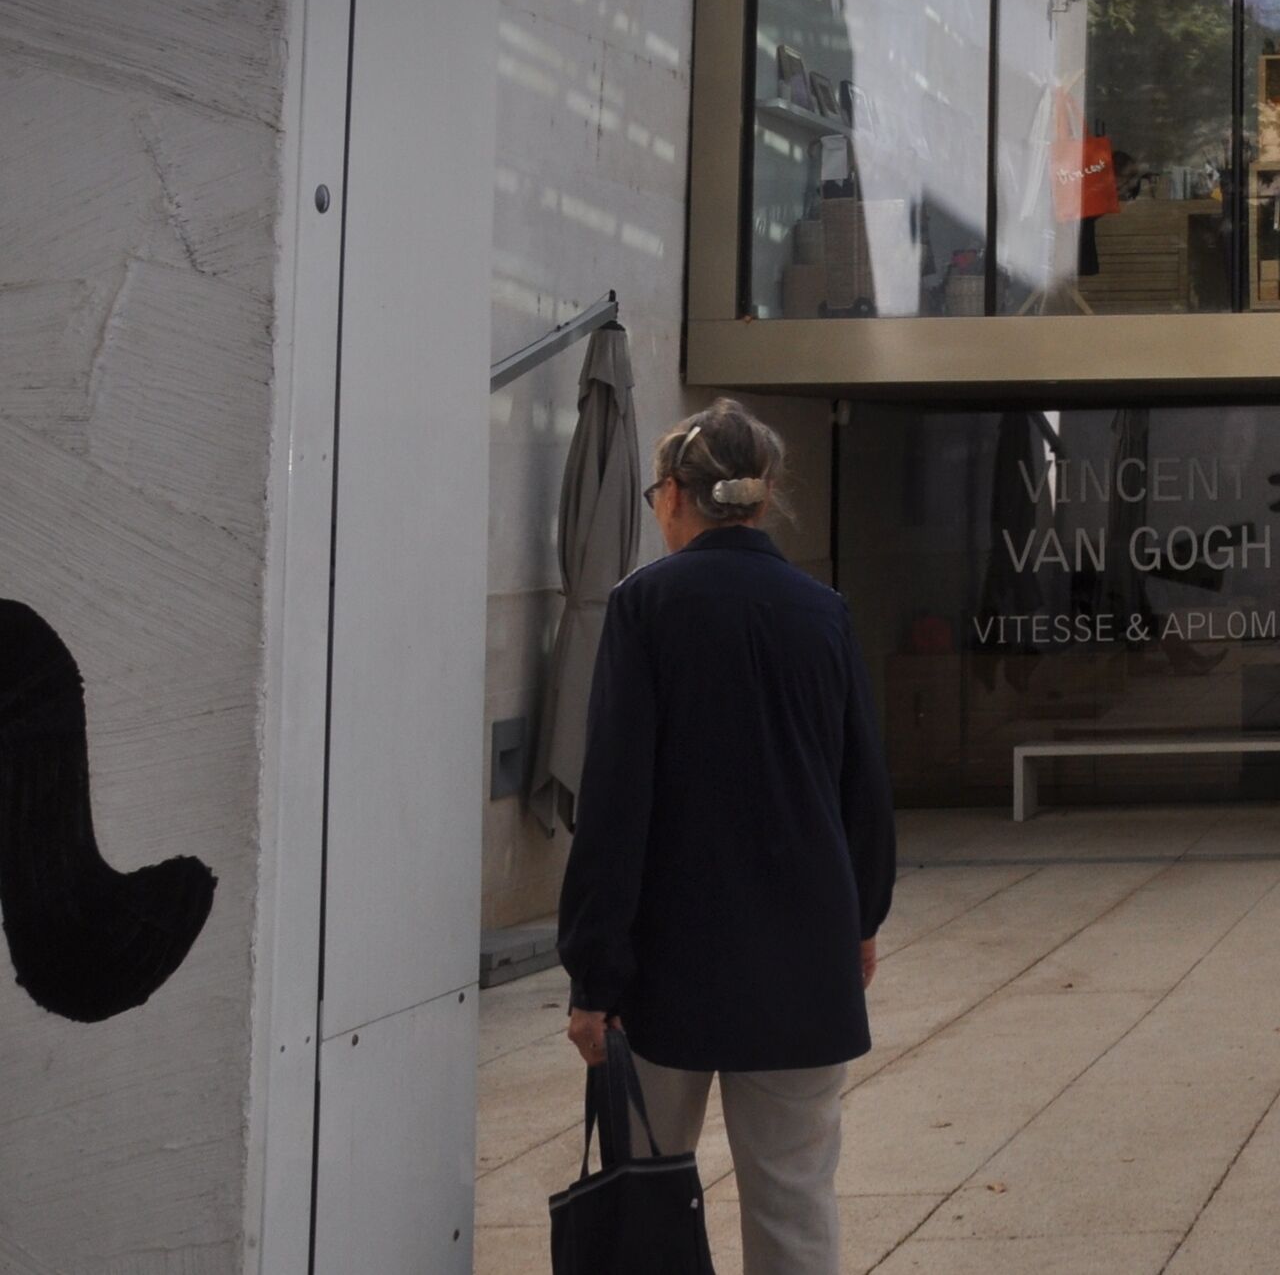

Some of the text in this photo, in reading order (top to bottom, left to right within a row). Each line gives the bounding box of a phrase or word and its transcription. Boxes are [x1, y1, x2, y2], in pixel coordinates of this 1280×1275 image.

[1018, 457, 1245, 504] VINCENT
[1002, 525, 1271, 573] VAN GOGH
[972, 613, 1115, 644] VITESSE
[1125, 612, 1151, 642] &
